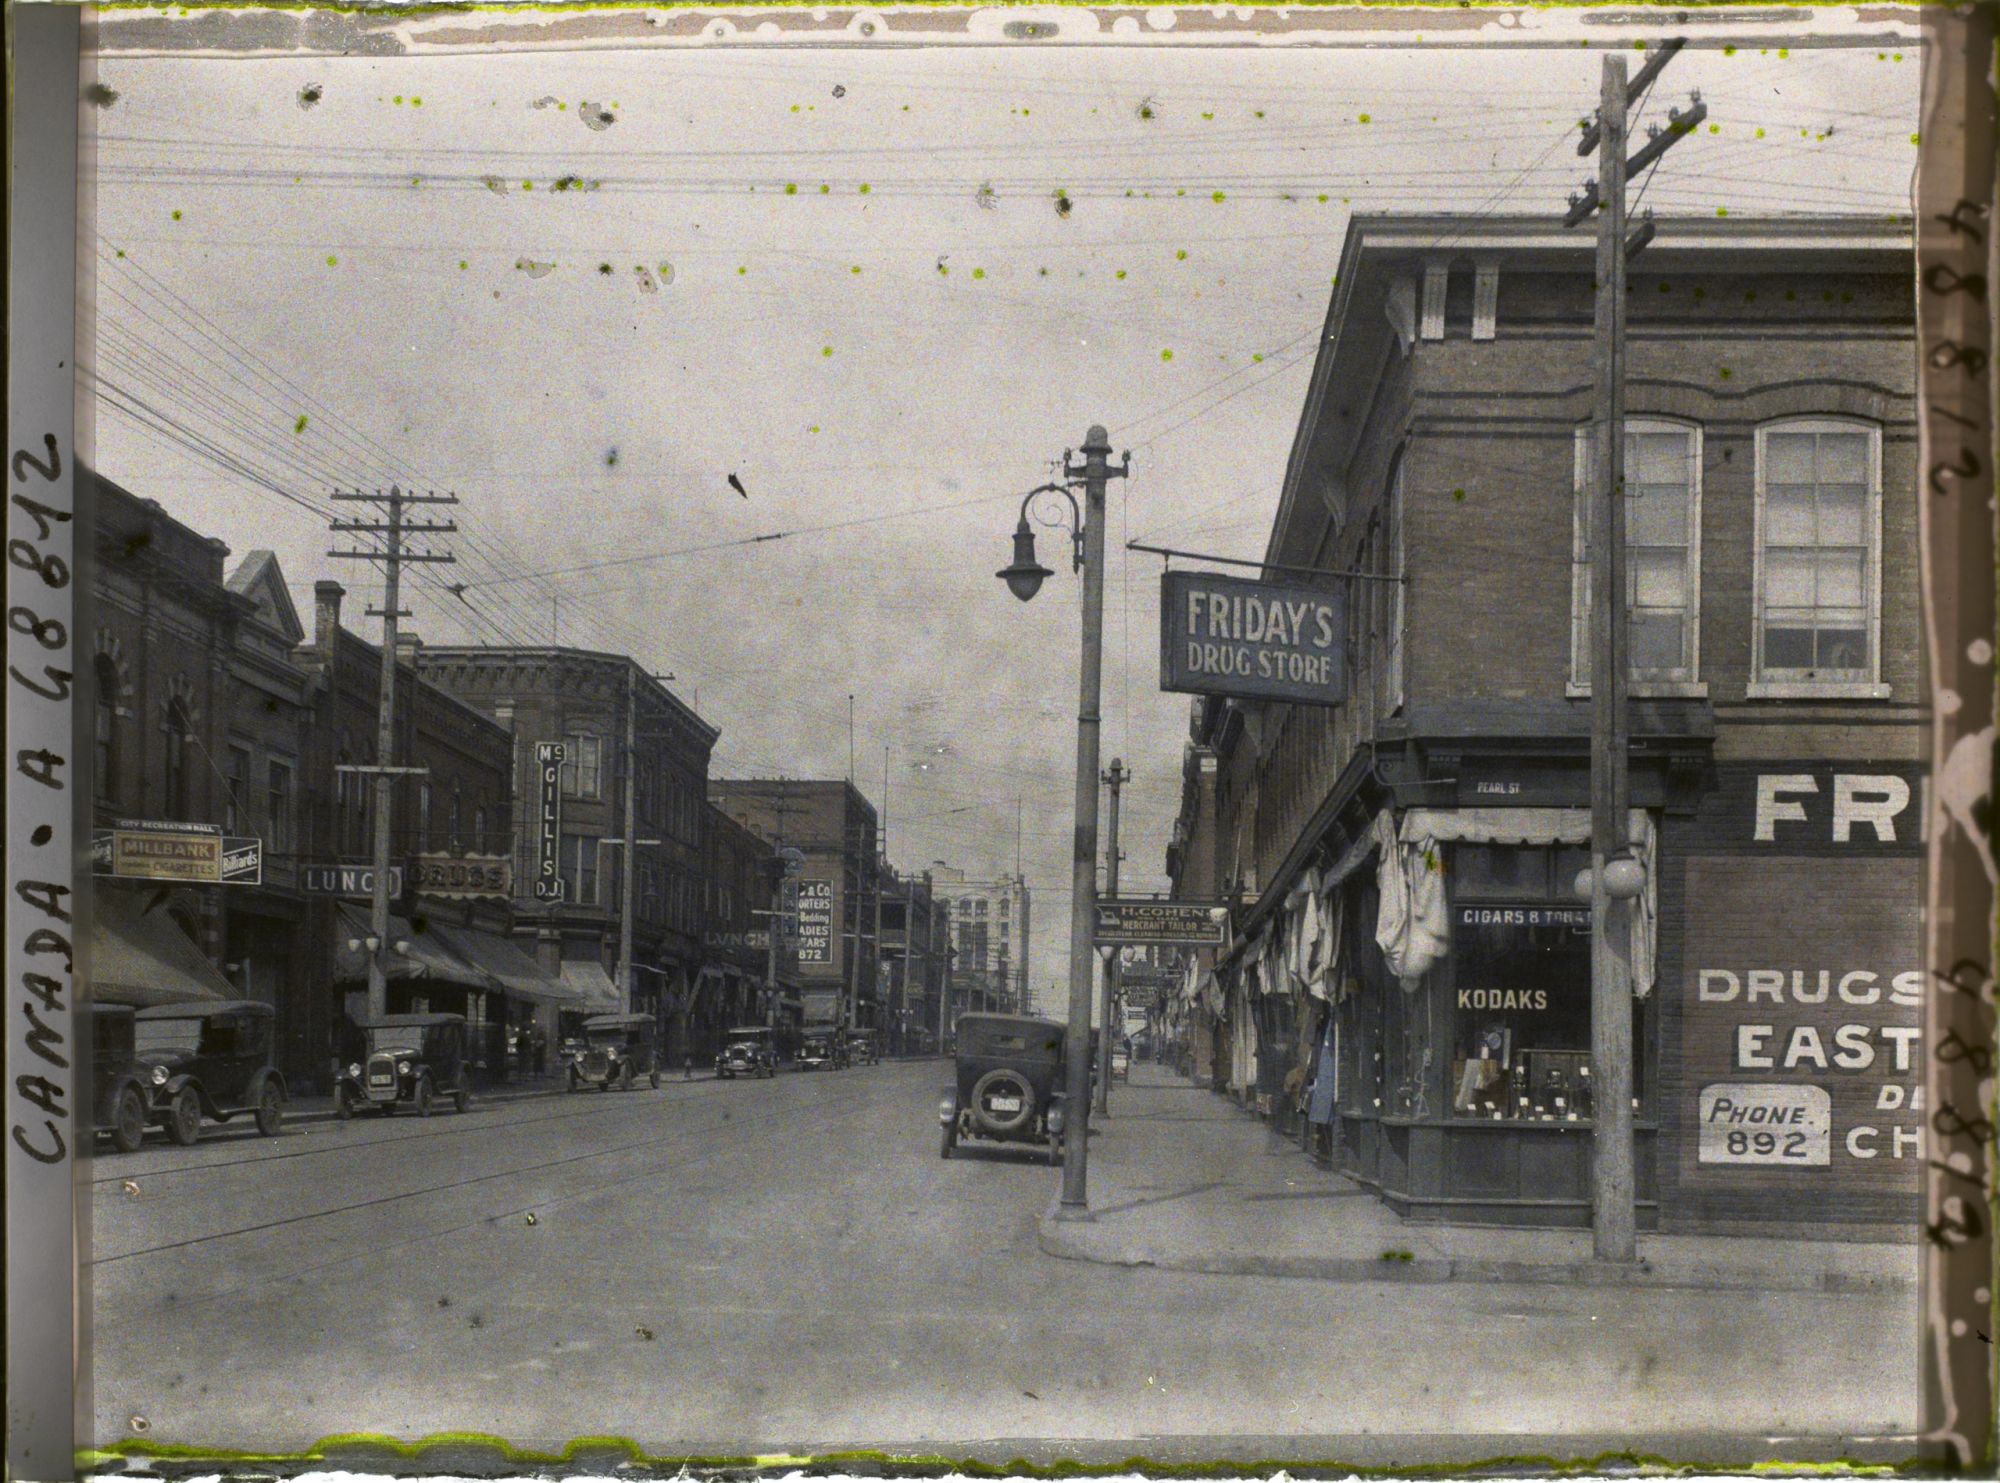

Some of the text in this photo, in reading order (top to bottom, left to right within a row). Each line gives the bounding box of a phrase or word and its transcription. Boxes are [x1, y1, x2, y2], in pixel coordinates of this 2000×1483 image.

[1187, 590, 1333, 648] FRIDAY'S
[1187, 641, 1331, 684] DRUG STORE
[16, 747, 65, 790] A
[1477, 781, 1520, 794] PEARL ST
[124, 840, 211, 858] MILLBANK
[222, 850, 258, 873] Billiards
[536, 881, 561, 896] D.J.
[1122, 920, 1165, 931] MERCHANT
[1168, 920, 1198, 932] TAILOR
[1463, 909, 1524, 924] CIGARS
[1458, 988, 1548, 1010] KODAKS
[1698, 969, 1924, 1006] DRUGS
[12, 878, 72, 1164] CANADA
[1738, 1023, 1922, 1070] EAST
[1726, 1131, 1808, 1159] 892
